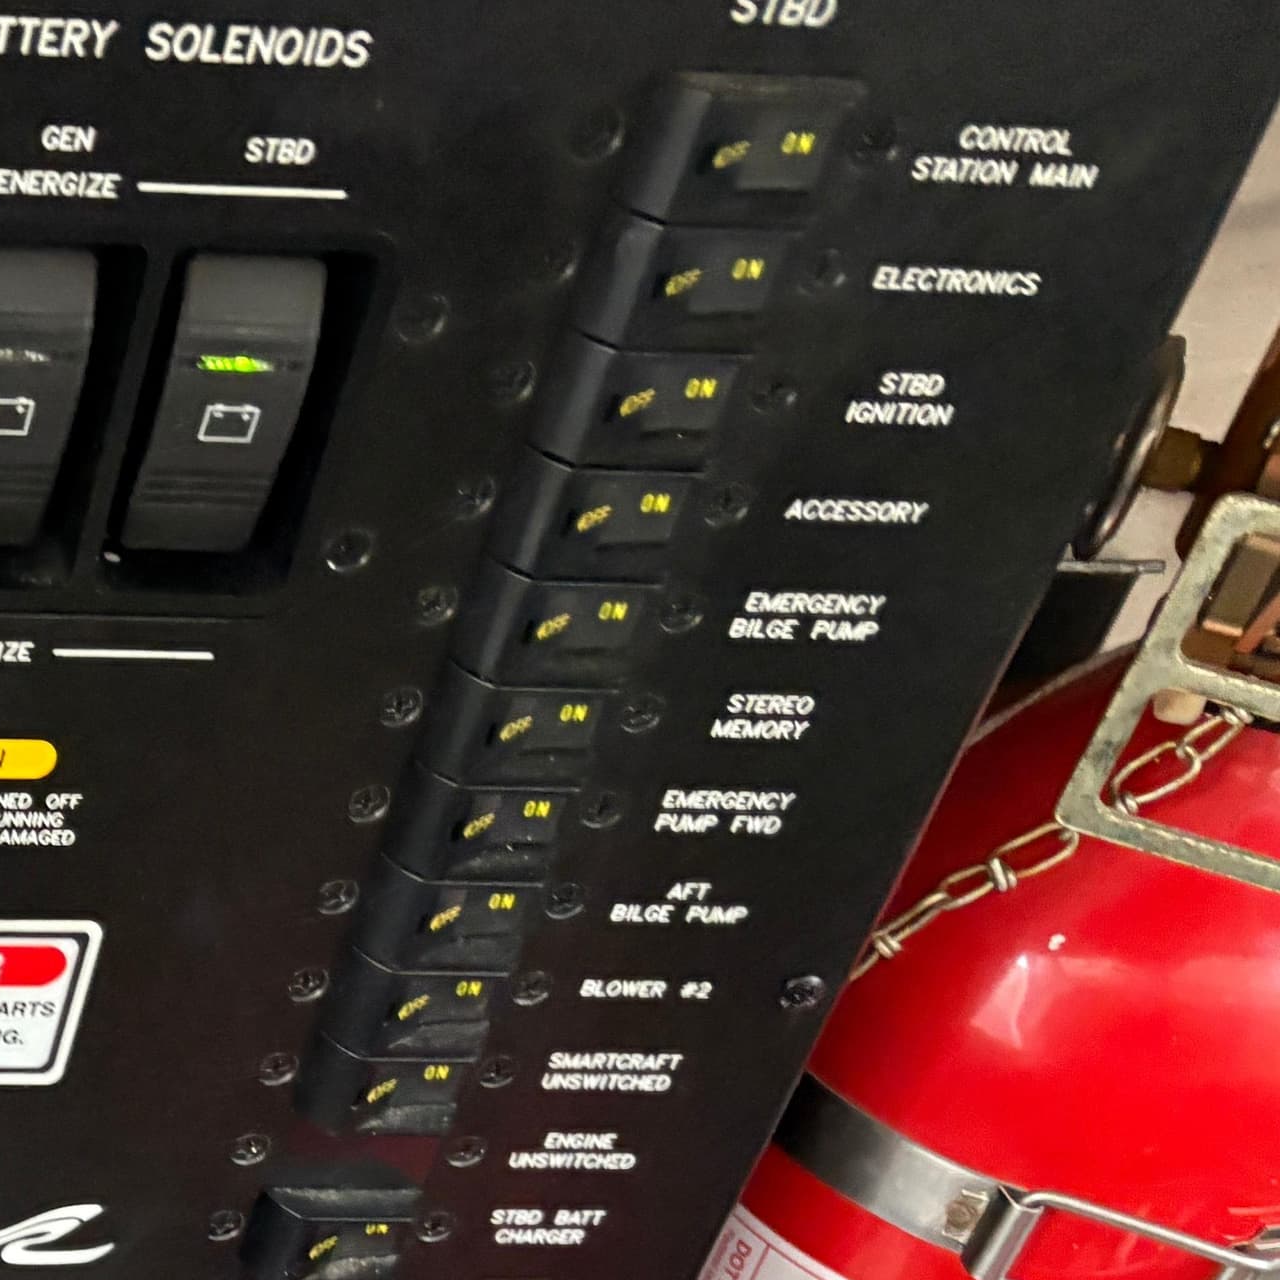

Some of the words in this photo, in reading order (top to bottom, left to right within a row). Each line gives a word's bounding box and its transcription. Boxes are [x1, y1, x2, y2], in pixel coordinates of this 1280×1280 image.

[145, 22, 373, 67] SOLENOIDS
[42, 125, 96, 151] GEN
[245, 137, 315, 164] STBD
[959, 125, 1072, 154] CONTROL
[912, 156, 1018, 184] STATION
[1029, 162, 1099, 188] MAIN
[872, 266, 1042, 296] ELECTRONICS
[879, 372, 945, 396] STBD
[845, 401, 954, 426] IGNITION
[784, 499, 929, 523] ACCESSORY
[745, 592, 886, 615] EMERGENCY
[729, 618, 800, 639] BILGE
[810, 620, 879, 641] PUMP
[727, 694, 815, 715] STEREO
[711, 719, 810, 739] MEMORY
[46, 793, 83, 810] OFF
[662, 790, 796, 810] EMERGENCY
[654, 813, 718, 832] PUMP
[730, 815, 782, 834] FWD
[667, 882, 712, 900] AFT
[610, 904, 674, 923] BILGE
[686, 905, 748, 923] PUMP
[580, 980, 667, 998] BLOWER
[680, 982, 712, 999] #2
[548, 1052, 683, 1070] SMARTCRAFT
[541, 1073, 671, 1091] UNSWITCHED
[544, 1132, 617, 1150] ENGINE
[509, 1152, 636, 1169] UNSWITCHED
[490, 1209, 544, 1225] STBD
[554, 1210, 606, 1226] BATT
[495, 1228, 585, 1245] CHARGER
